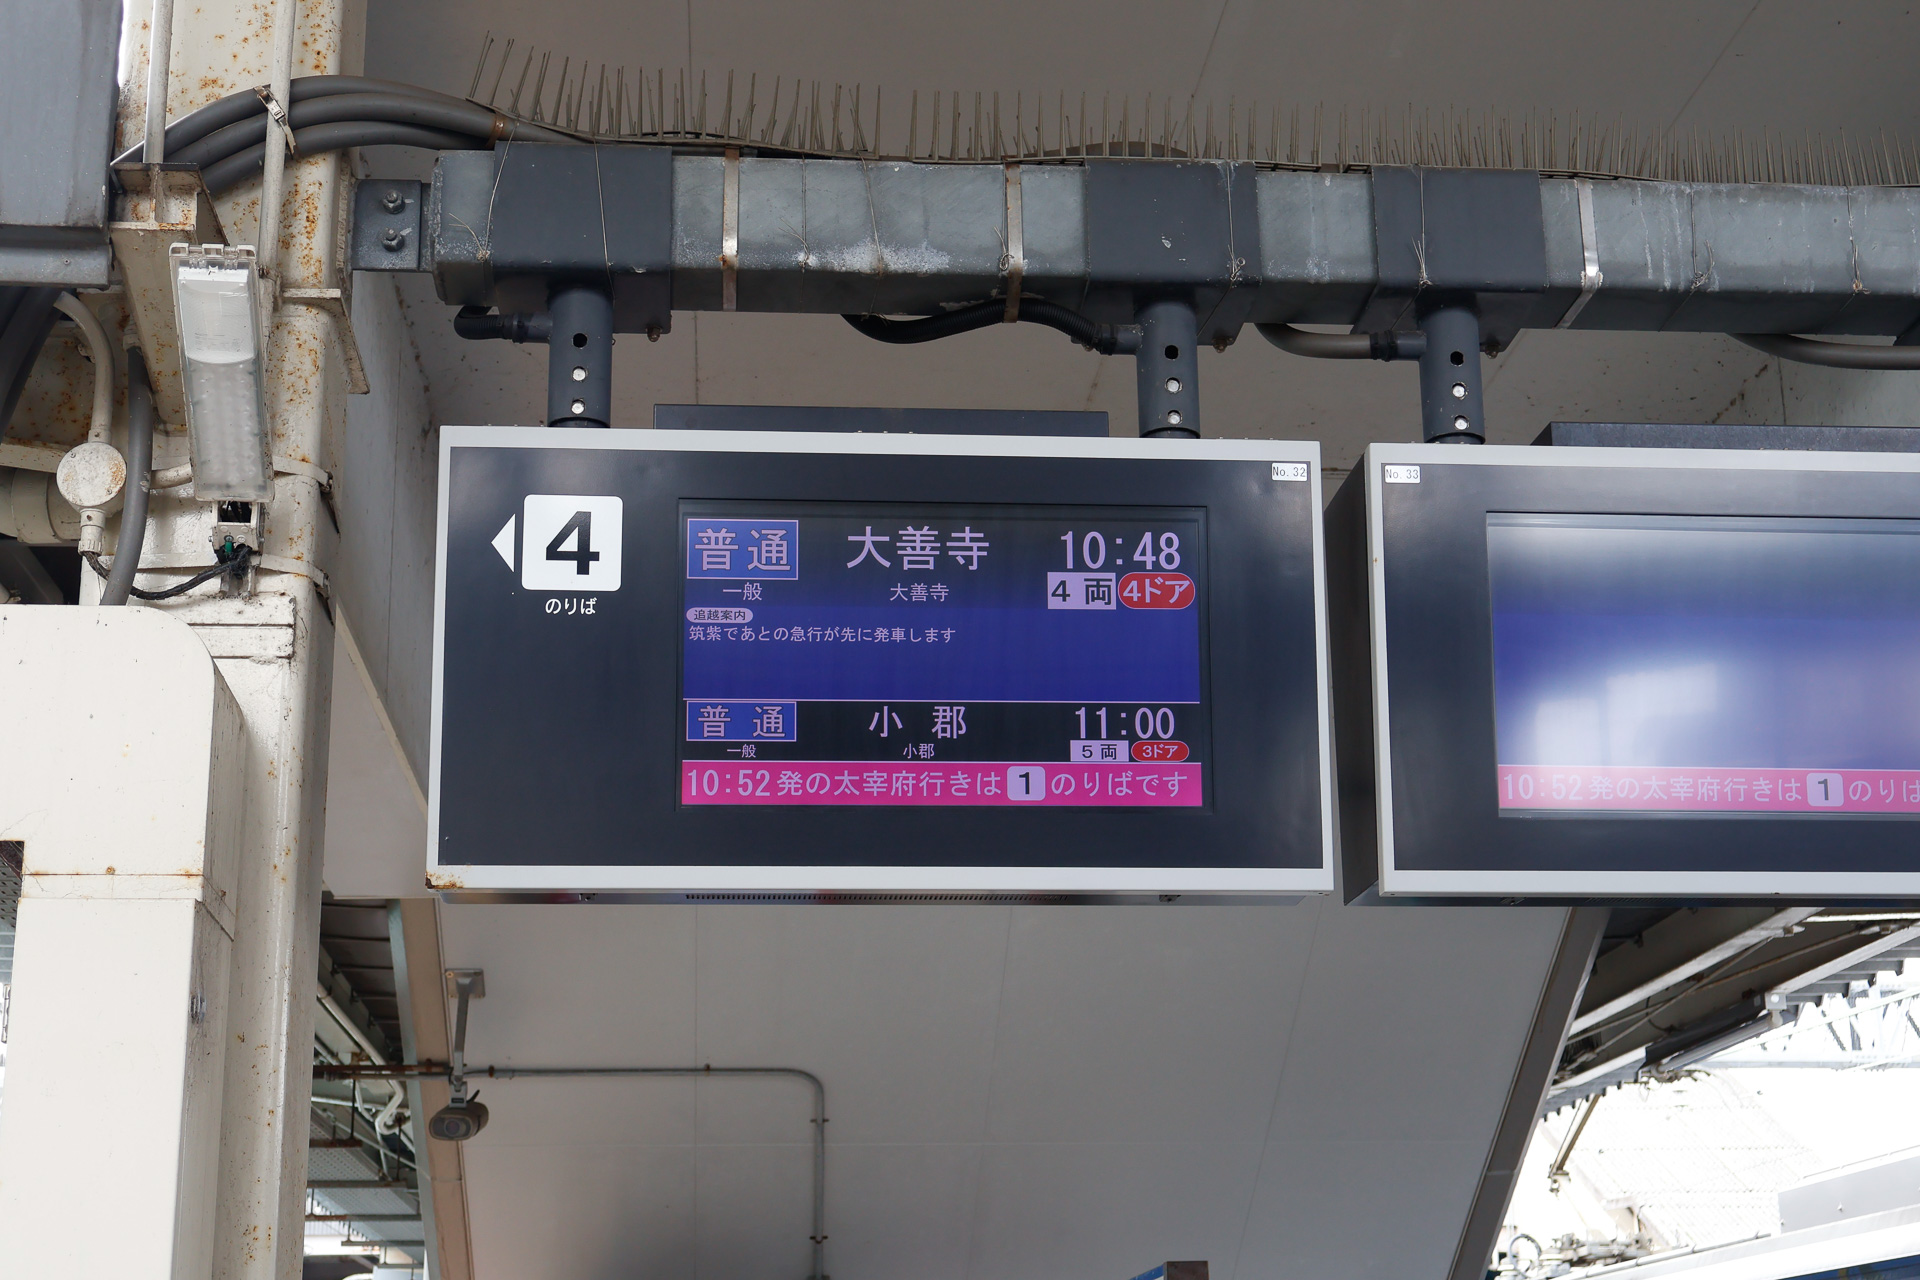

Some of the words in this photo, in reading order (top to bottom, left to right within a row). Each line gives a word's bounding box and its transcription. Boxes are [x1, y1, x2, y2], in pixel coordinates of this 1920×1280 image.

[545, 510, 600, 576] 4
[694, 527, 791, 572] 普通
[846, 525, 990, 571] 大善寺
[1060, 531, 1181, 570] 10:48
[722, 582, 763, 601] 一般
[889, 582, 950, 602] 大善寺
[1122, 576, 1191, 604] 4ドア
[545, 597, 597, 615] のりば
[693, 609, 747, 622] 追越案内
[688, 625, 956, 643] 筑紫であとの急行が先に発車します
[698, 705, 786, 738] 普通
[1075, 706, 1176, 740] 11:00
[726, 743, 757, 759] 一般
[902, 743, 935, 760] 小郡
[1141, 742, 1179, 759] 3ドア
